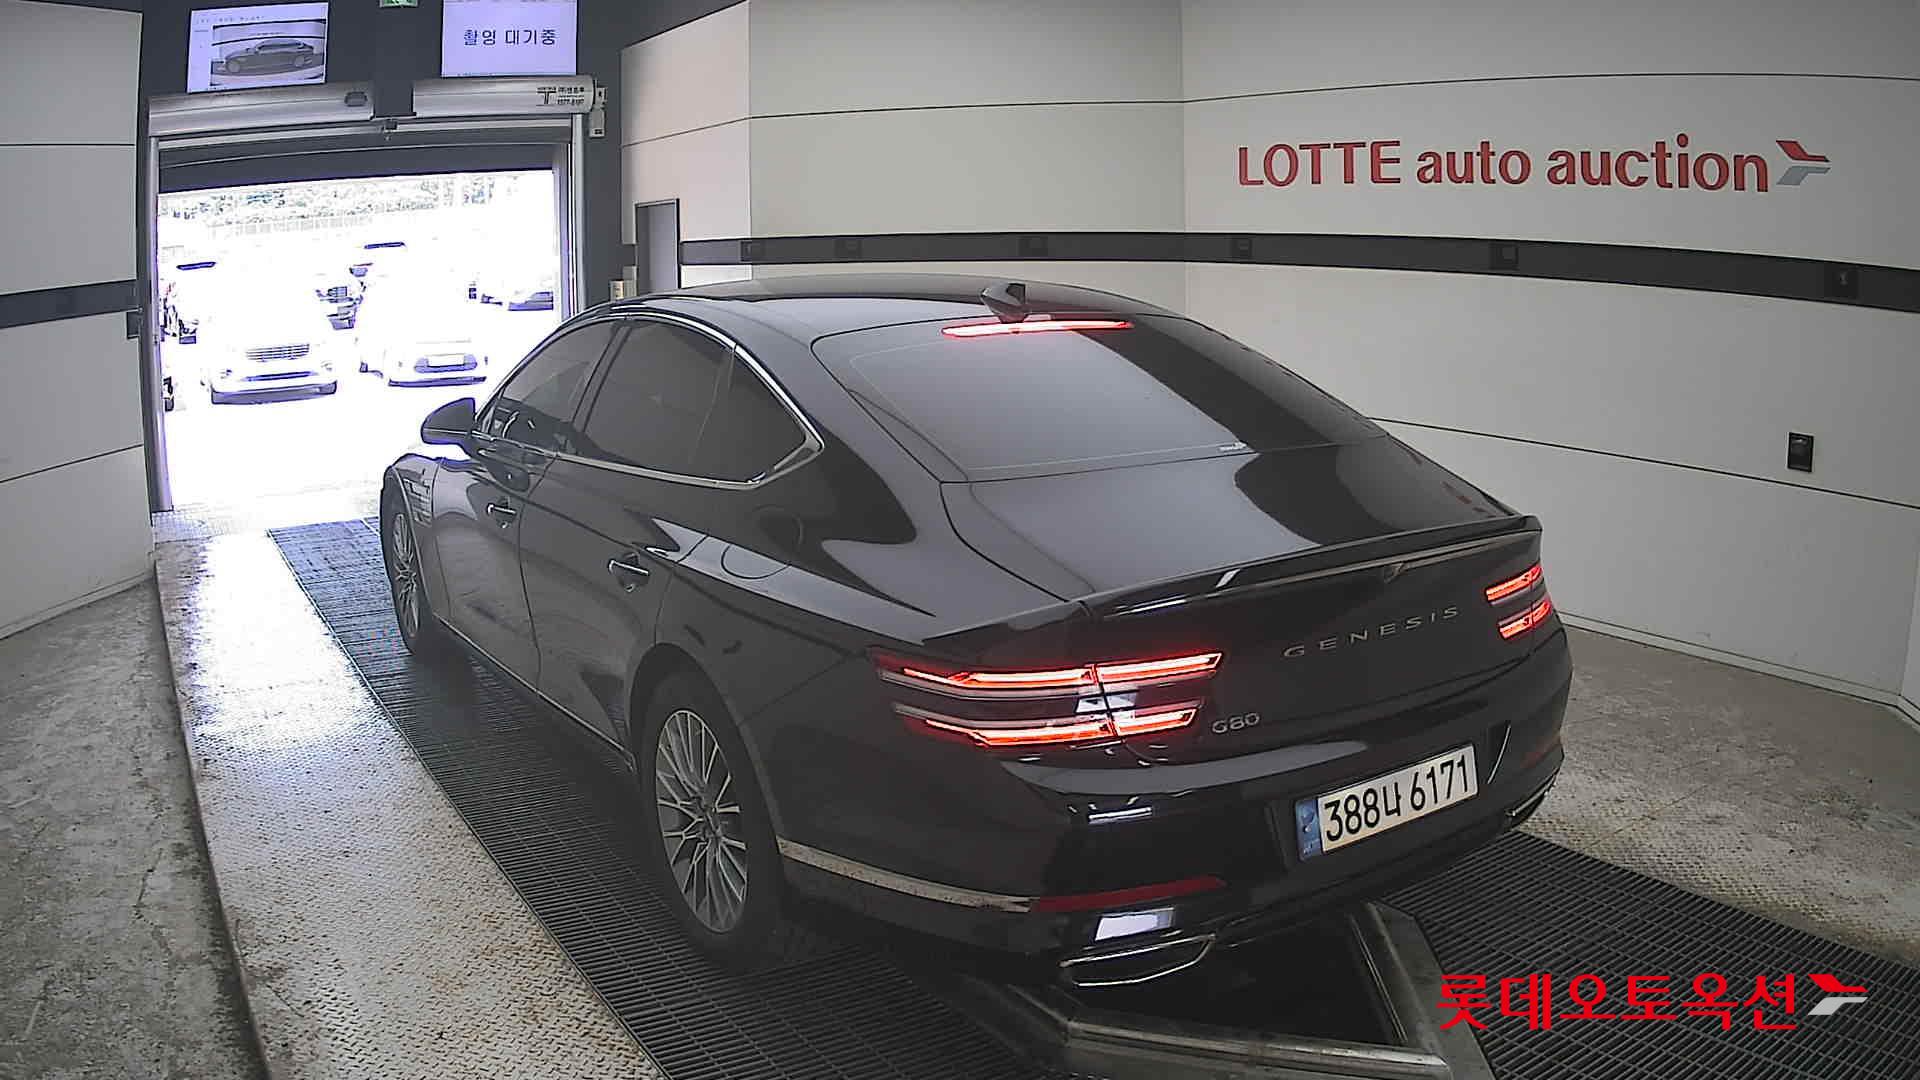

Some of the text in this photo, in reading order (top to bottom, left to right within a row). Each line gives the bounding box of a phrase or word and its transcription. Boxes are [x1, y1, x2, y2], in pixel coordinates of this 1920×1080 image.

[504, 29, 556, 46] 대기중
[1237, 134, 1769, 193] LOTTE auto auction
[1283, 606, 1460, 658] GENESIS
[1211, 711, 1261, 734] G80
[1410, 754, 1469, 811] 6171
